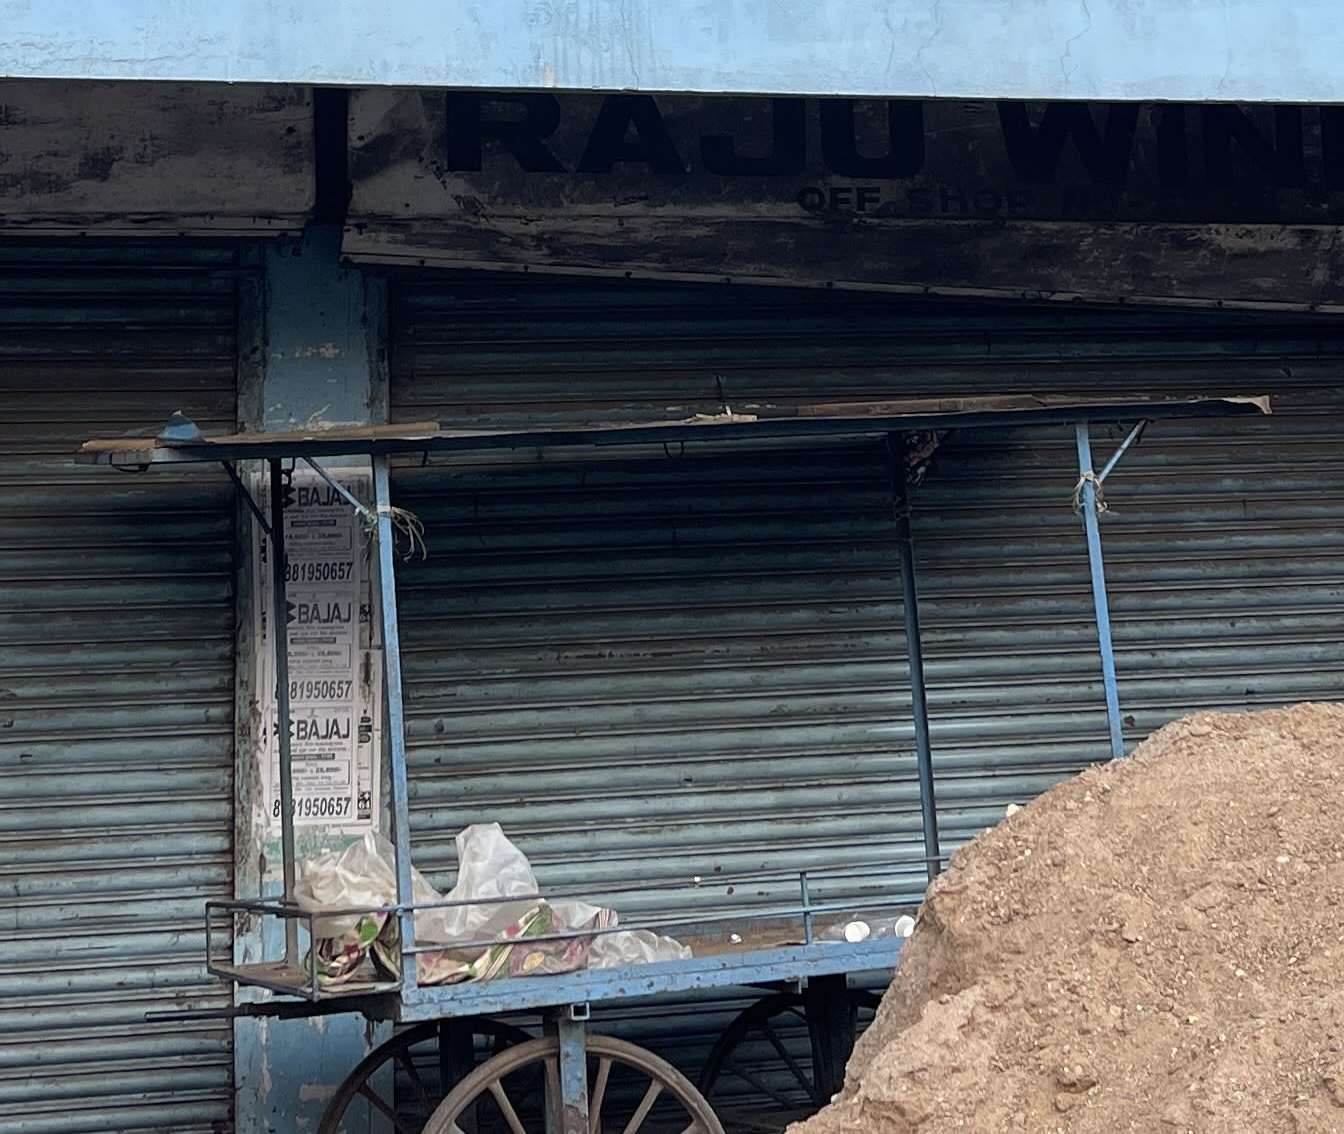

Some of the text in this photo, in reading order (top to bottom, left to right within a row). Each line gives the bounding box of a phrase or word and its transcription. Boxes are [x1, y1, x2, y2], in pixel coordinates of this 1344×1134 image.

[446, 92, 925, 179] RAJU
[797, 186, 881, 213] OFF
[907, 187, 1028, 216] SHOP
[298, 486, 352, 506] BAJAJ
[298, 603, 351, 624] BAJAJ
[297, 718, 350, 740] BAJAJ
